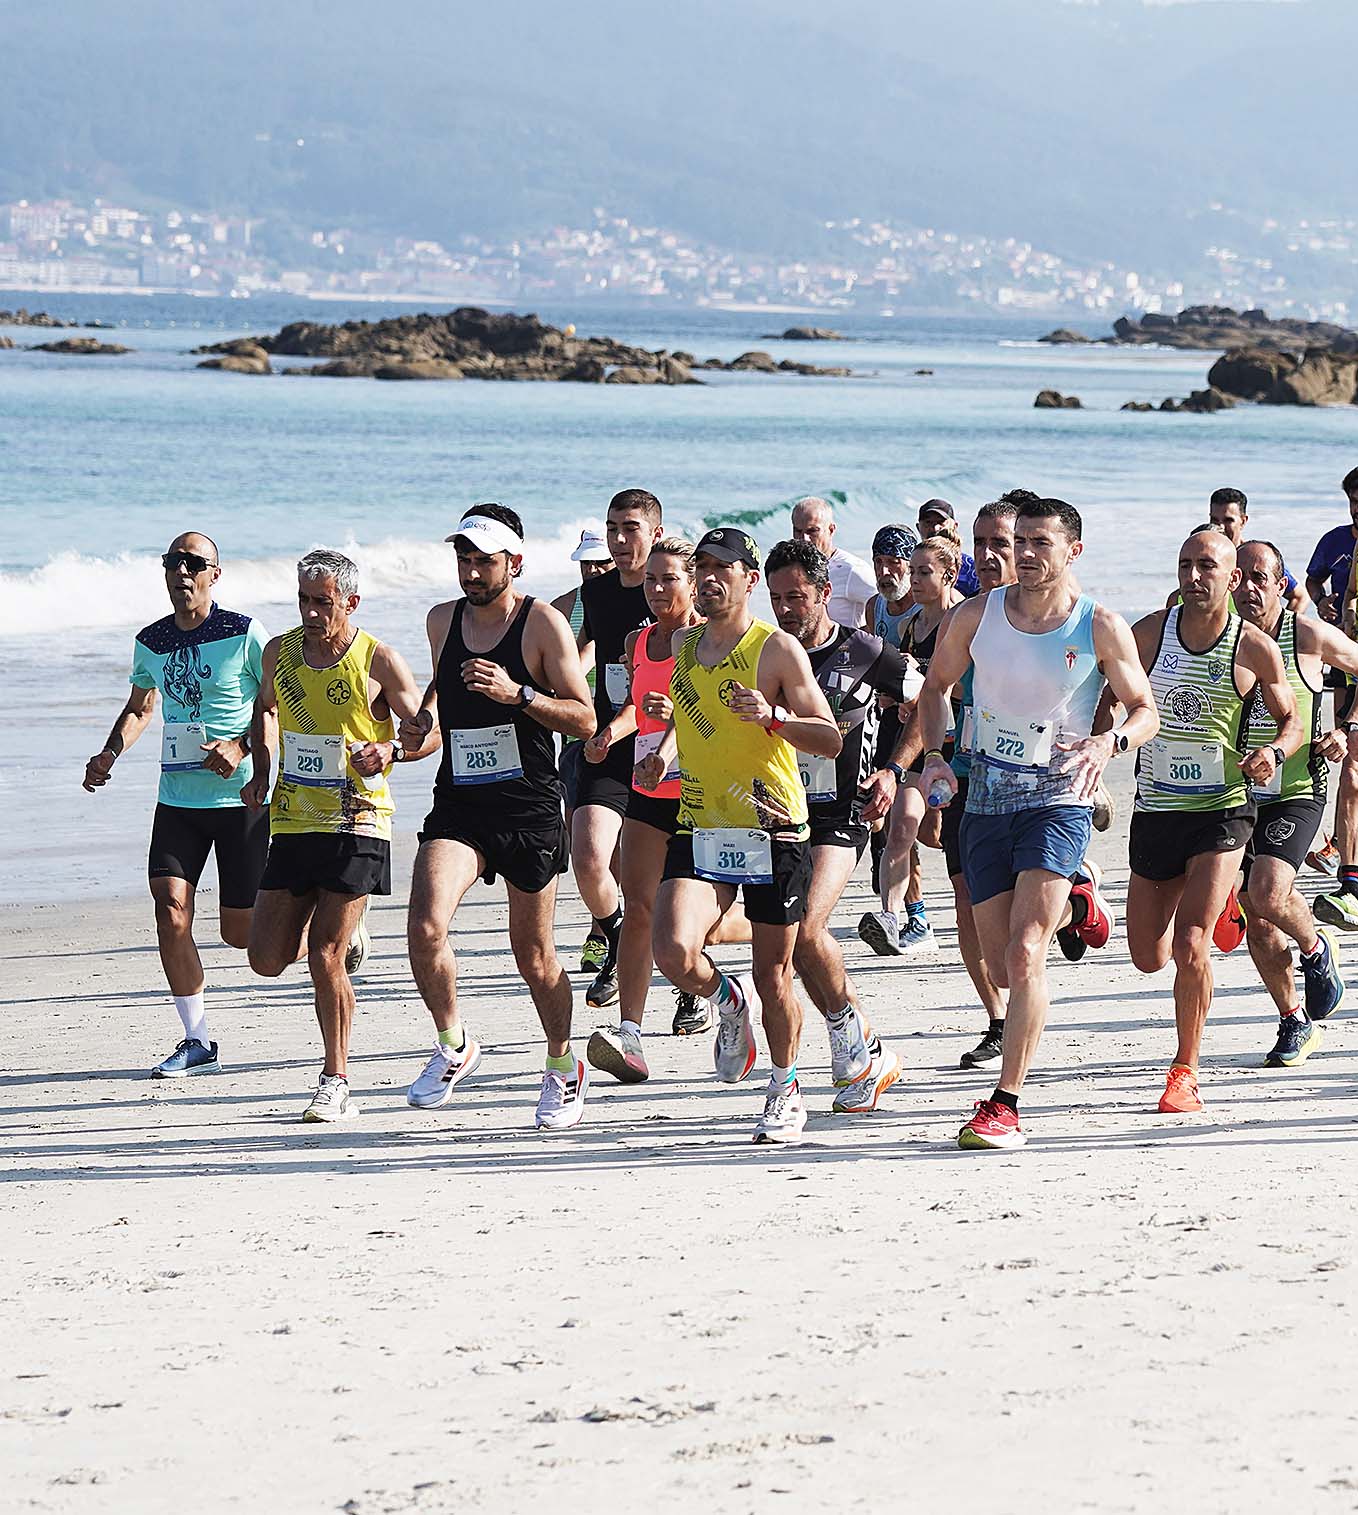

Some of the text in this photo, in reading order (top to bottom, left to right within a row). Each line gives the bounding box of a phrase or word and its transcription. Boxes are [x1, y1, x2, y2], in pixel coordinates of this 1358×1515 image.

[998, 728, 1020, 738] MANUEL
[170, 744, 177, 758] 1
[474, 741, 499, 749] ANTONIO
[995, 736, 1025, 758] 272
[297, 756, 324, 773] 229
[466, 750, 498, 769] 283
[1169, 763, 1202, 780] 308
[718, 851, 746, 868] 312
